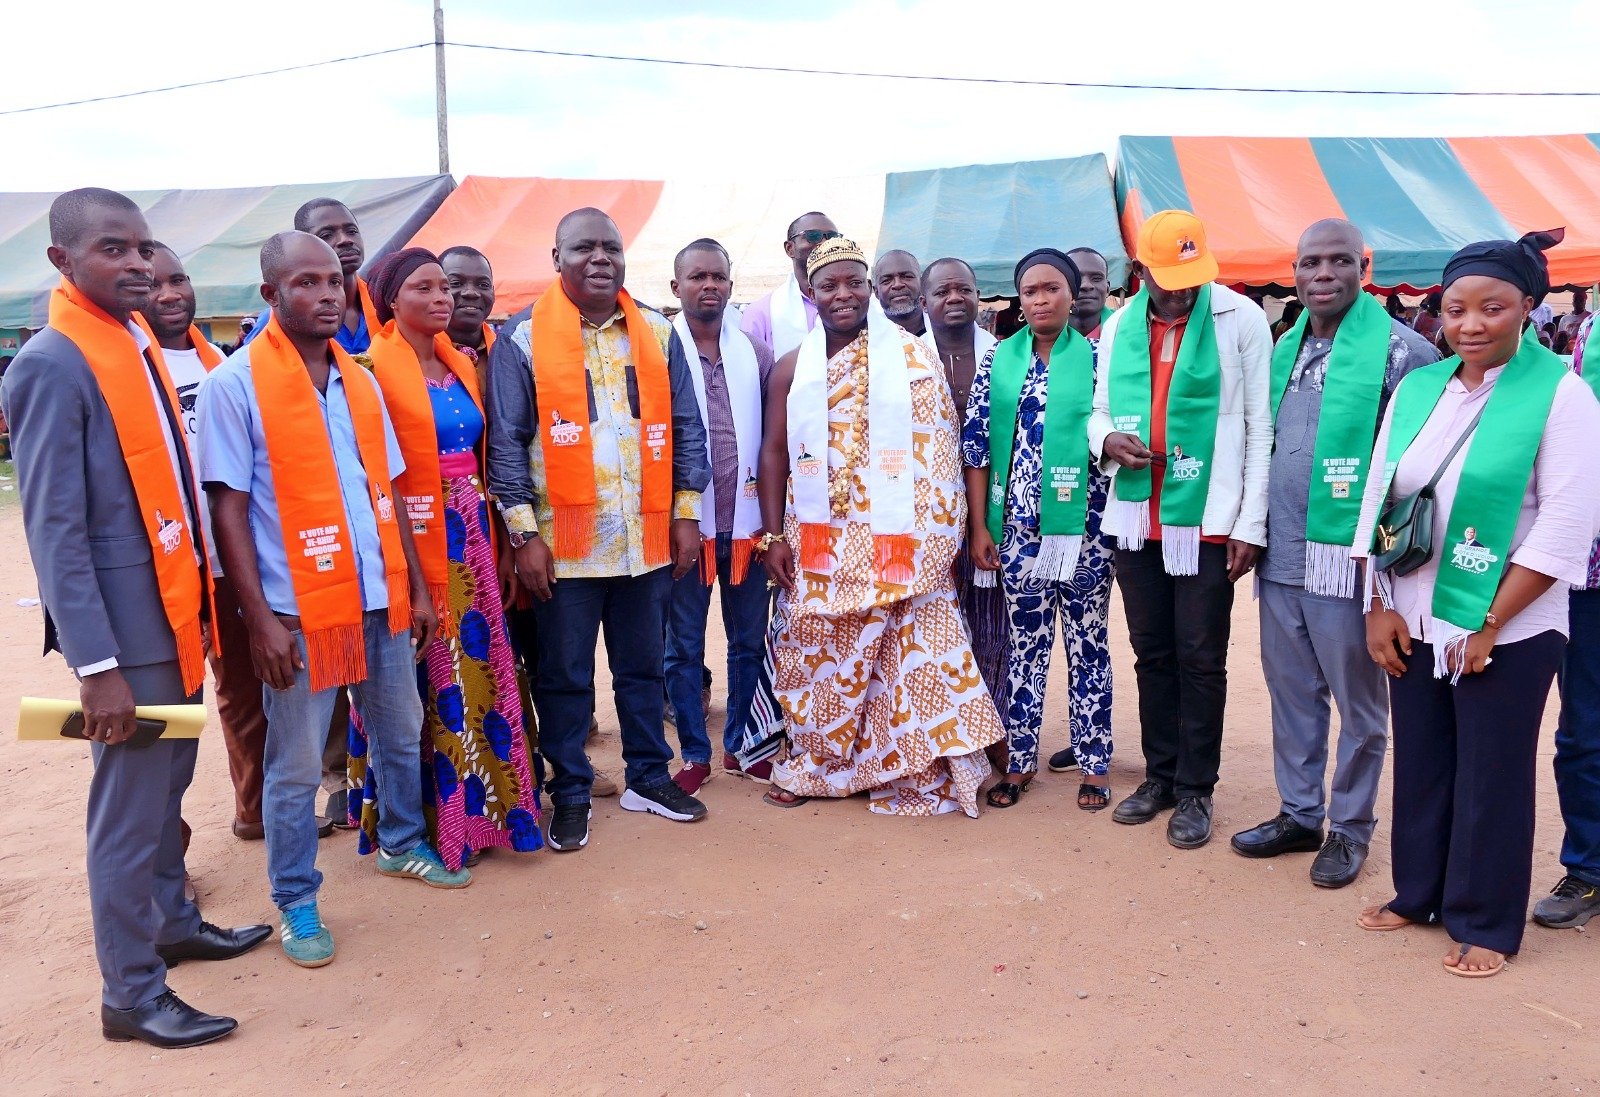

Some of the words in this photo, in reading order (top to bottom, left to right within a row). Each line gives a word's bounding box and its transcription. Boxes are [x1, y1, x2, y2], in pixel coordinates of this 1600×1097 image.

[552, 432, 581, 444] ADO
[799, 465, 819, 475] ADO
[1173, 467, 1199, 479] ADO
[306, 527, 325, 539] VOTE
[164, 532, 181, 554] ADO
[1450, 554, 1489, 573] ADO
